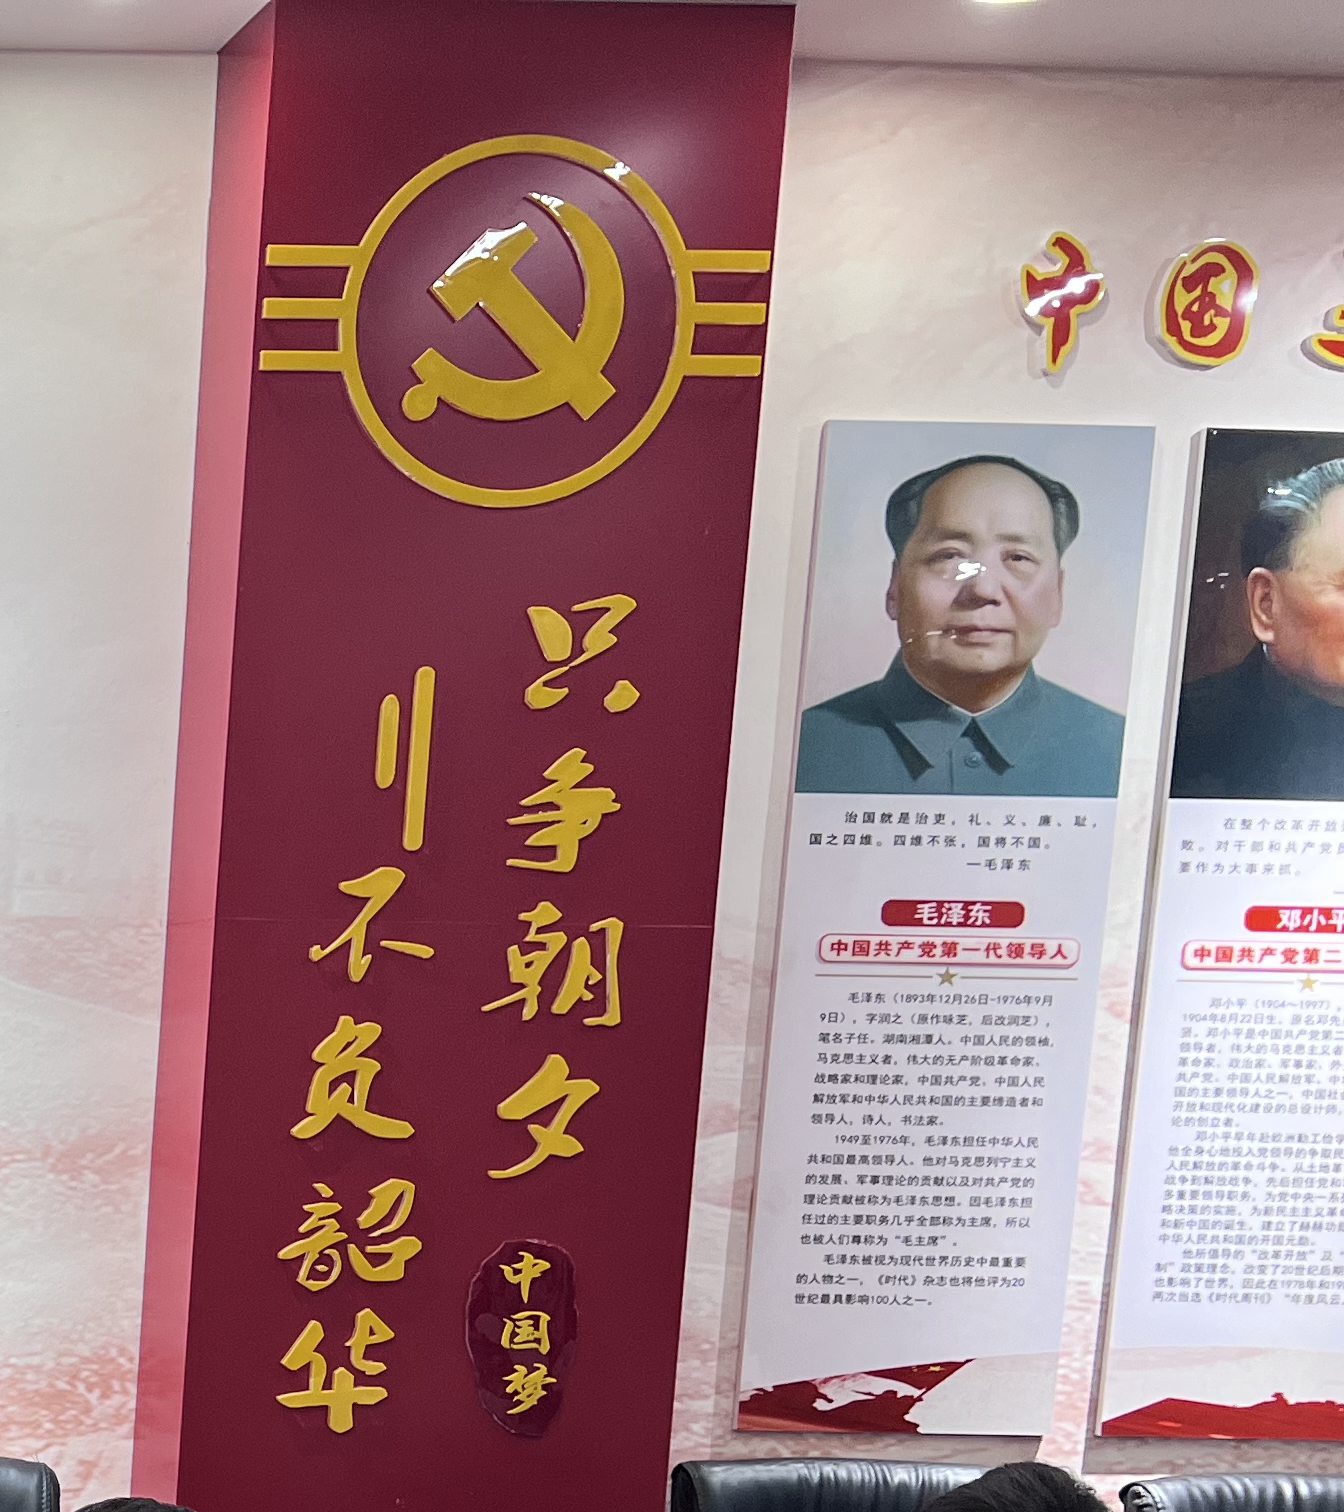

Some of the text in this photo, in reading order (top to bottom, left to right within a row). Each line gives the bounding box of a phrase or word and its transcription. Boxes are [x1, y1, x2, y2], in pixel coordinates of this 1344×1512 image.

[1020, 231, 1344, 373] 中国
[1224, 818, 1344, 832] 在整个改革开放
[482, 594, 640, 1179] 只争朝夕
[914, 902, 993, 925] 毛泽东
[830, 939, 1068, 961] 中国共产党第一代领导人
[500, 1251, 556, 1414] 中国梦
